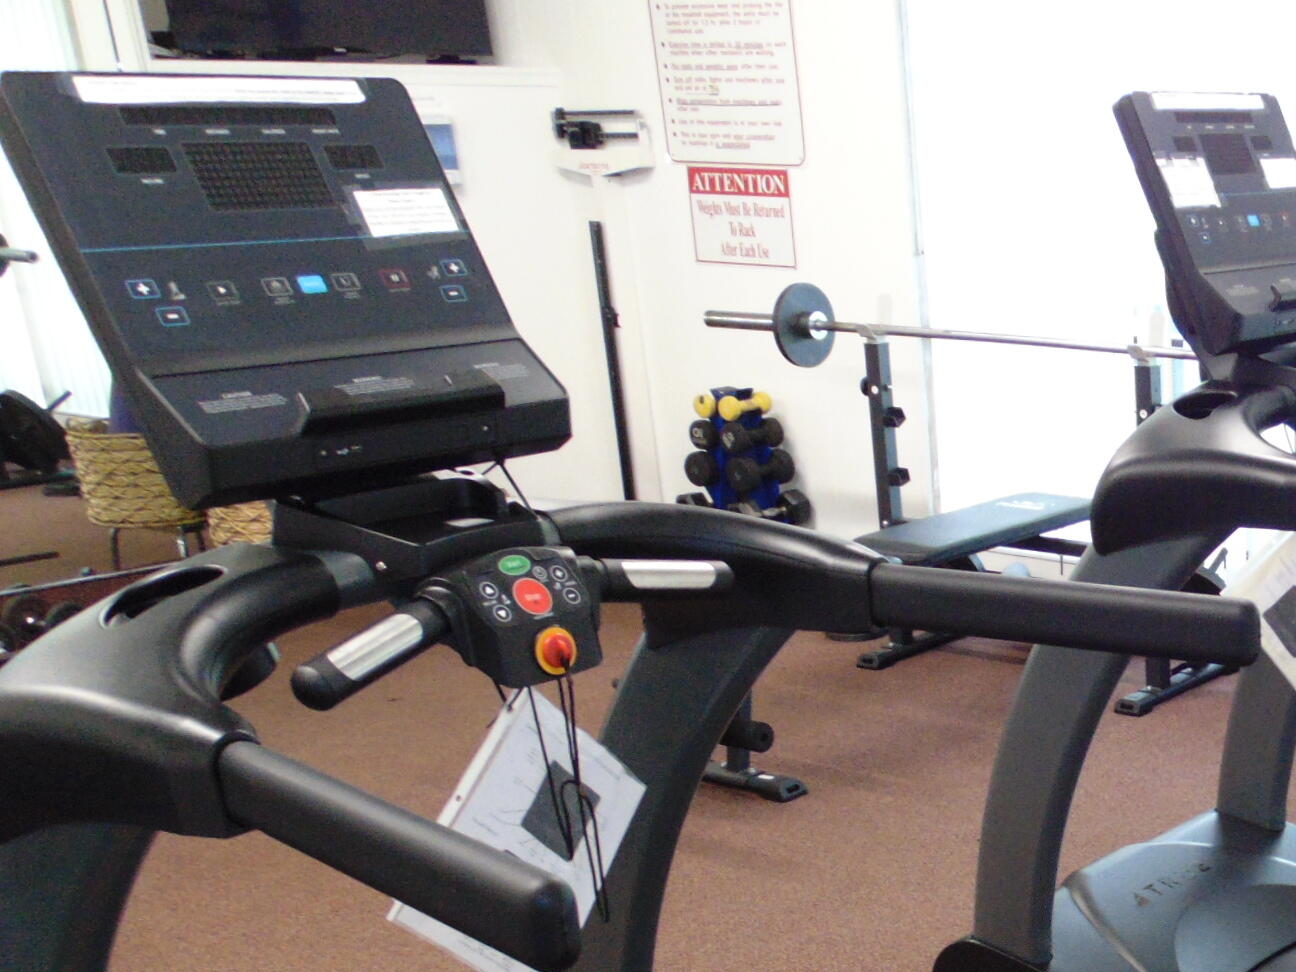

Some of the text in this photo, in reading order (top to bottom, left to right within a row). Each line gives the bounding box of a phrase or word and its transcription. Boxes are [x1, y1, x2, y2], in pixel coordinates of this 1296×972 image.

[693, 172, 785, 194] ATTENTION
[696, 200, 785, 218] Weights Must Be Returned
[729, 221, 756, 237] To Rack
[739, 242, 756, 258] Each
